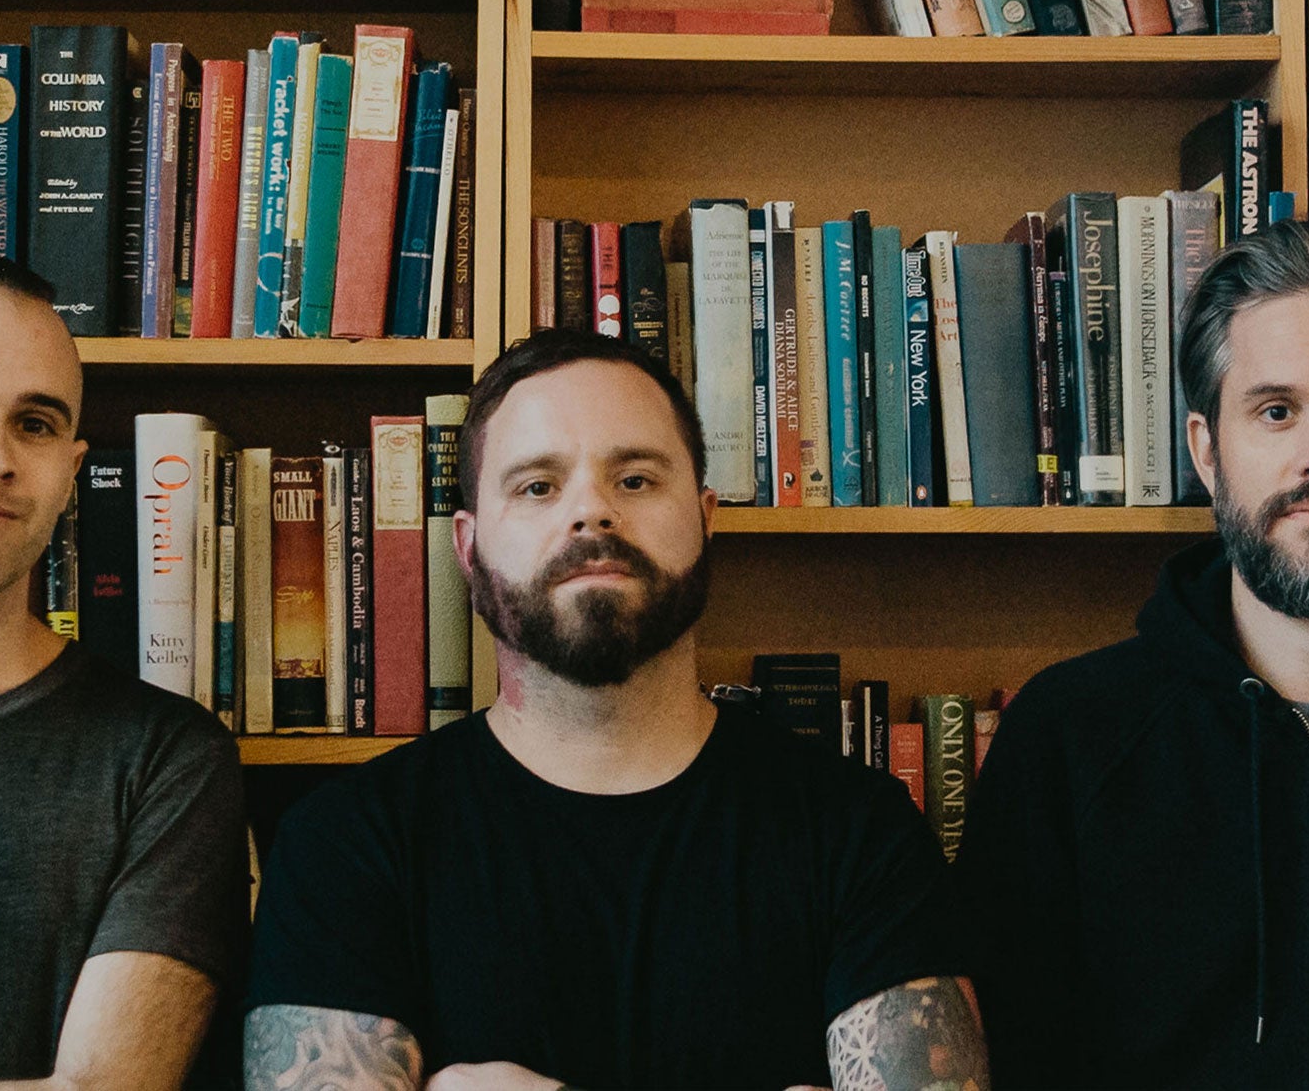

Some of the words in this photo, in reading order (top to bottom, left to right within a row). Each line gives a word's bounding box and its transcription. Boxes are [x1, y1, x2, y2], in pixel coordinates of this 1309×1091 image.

[41, 74, 105, 86] COLUMBIA
[165, 59, 178, 91] Progress
[49, 100, 105, 112] HISTORY
[166, 97, 176, 106] in
[222, 95, 235, 123] THE
[272, 78, 290, 136] racket
[462, 98, 472, 119] Bruce
[40, 128, 49, 137] OF
[61, 126, 106, 138] WORLD
[163, 111, 177, 163] Archaeology
[294, 112, 309, 171] MOSAICS
[1242, 107, 1259, 147] THE
[221, 129, 234, 161] TWO
[245, 126, 263, 185] WINTER'S
[268, 142, 287, 192] work:
[67, 180, 78, 189] by
[458, 178, 471, 207] THE
[1242, 150, 1258, 235] ASTRON
[241, 193, 259, 230] LIGHT
[182, 222, 193, 246] ITALIAN
[455, 207, 470, 284] SONGLINES
[1140, 217, 1156, 281] MORNINGS
[1185, 227, 1207, 263] The
[906, 250, 926, 275] Time
[1080, 211, 1116, 341] Josephine
[906, 275, 926, 298] Out
[1034, 266, 1046, 304] Everyman
[1140, 283, 1156, 300] ON
[839, 281, 852, 341] Coetzee
[933, 298, 958, 309] The
[774, 321, 785, 361] DIANA
[784, 309, 797, 377] GERTRUDE
[939, 330, 958, 342] Art
[1037, 315, 1049, 343] Europe
[1140, 303, 1158, 380] HORSEBACK
[807, 335, 819, 374] Ladies
[910, 329, 927, 368] New
[754, 385, 766, 417] DAVID
[775, 362, 786, 419] SOUHAMI
[785, 379, 796, 391] &
[911, 370, 929, 406] York
[787, 394, 799, 432] ALICE
[440, 432, 456, 441] THE
[755, 418, 767, 457] MELTZER
[91, 466, 123, 476] Future
[91, 478, 122, 488] Shock
[223, 461, 233, 484] Your
[273, 471, 313, 483] SMALL
[352, 459, 360, 483] Guide
[352, 484, 359, 493] to
[143, 455, 191, 576] Oprah
[222, 508, 233, 524] of
[273, 489, 316, 522] GIANT
[351, 497, 364, 531] Laos
[327, 521, 342, 571] NAPLES
[351, 536, 364, 548] &
[351, 552, 366, 629] Cambodia
[150, 634, 185, 651] Kitty
[146, 651, 191, 668] Kelley
[354, 699, 366, 728] Bradt
[875, 715, 885, 724] A
[942, 701, 964, 763] ONLY
[942, 769, 965, 813] ONE
